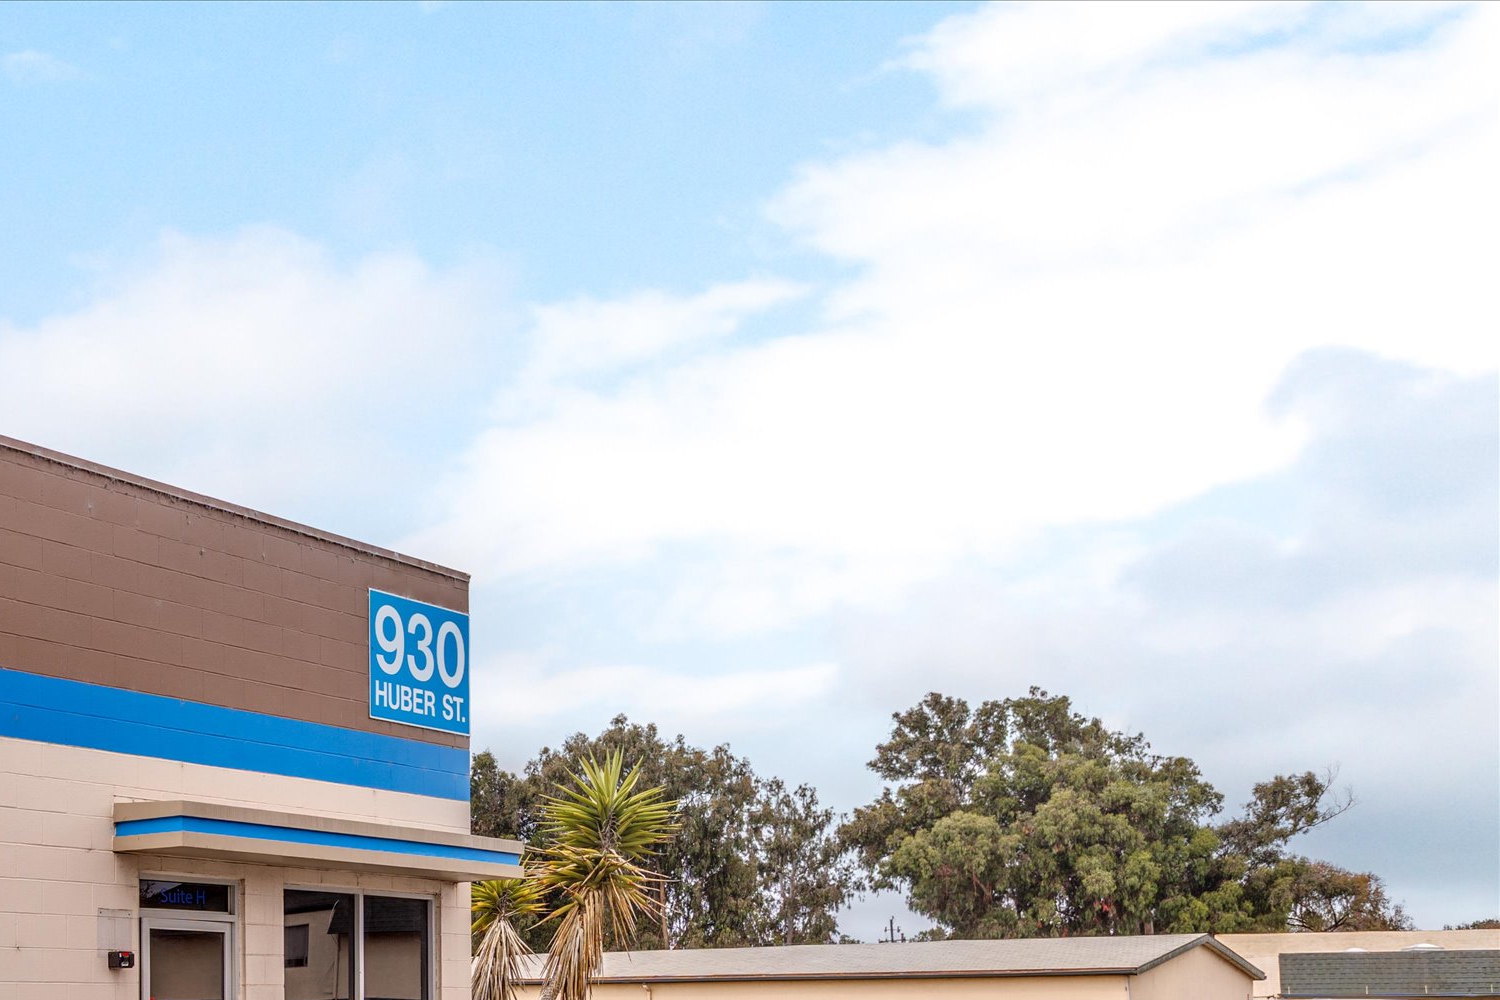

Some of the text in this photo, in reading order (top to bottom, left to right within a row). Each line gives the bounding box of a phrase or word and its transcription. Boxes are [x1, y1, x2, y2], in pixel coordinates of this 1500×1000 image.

[375, 604, 465, 689] 930
[375, 680, 466, 723] HUBER ST.
[160, 888, 205, 905] Suite H
